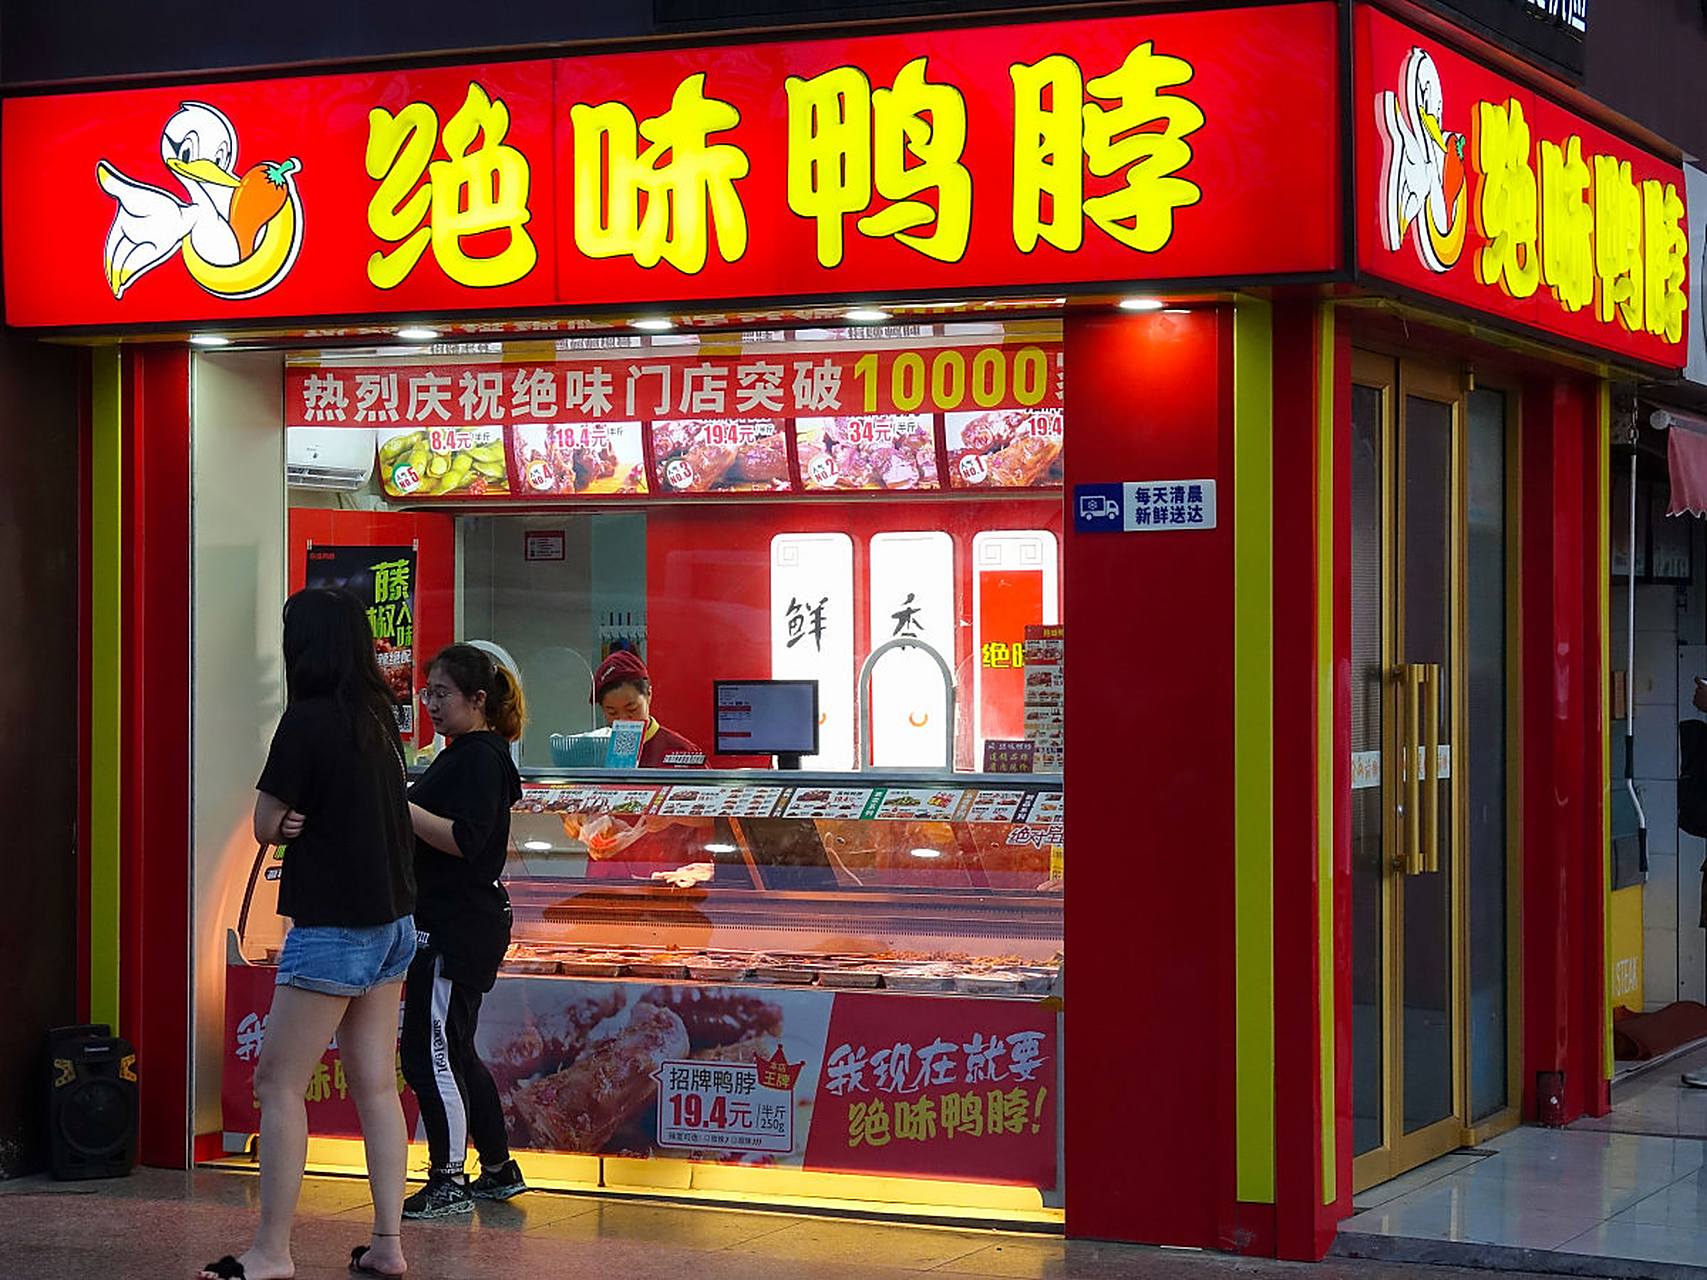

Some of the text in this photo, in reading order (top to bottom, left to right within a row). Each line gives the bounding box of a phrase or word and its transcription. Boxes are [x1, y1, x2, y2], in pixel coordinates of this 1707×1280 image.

[367, 41, 1205, 290] 绝味鸭脖
[1472, 97, 1688, 345] 绝味鸭脖
[1135, 485, 1203, 505] 每天清晨
[1135, 505, 1203, 525] 新鲜送达
[785, 597, 829, 652] 鲜
[669, 1067, 756, 1095] 招牌鸭脖
[824, 1030, 1051, 1096] 我现在就要
[669, 1093, 753, 1129] 19.4元
[761, 1118, 785, 1133] 250g
[847, 1086, 1048, 1148] 绝味鸭脖!
